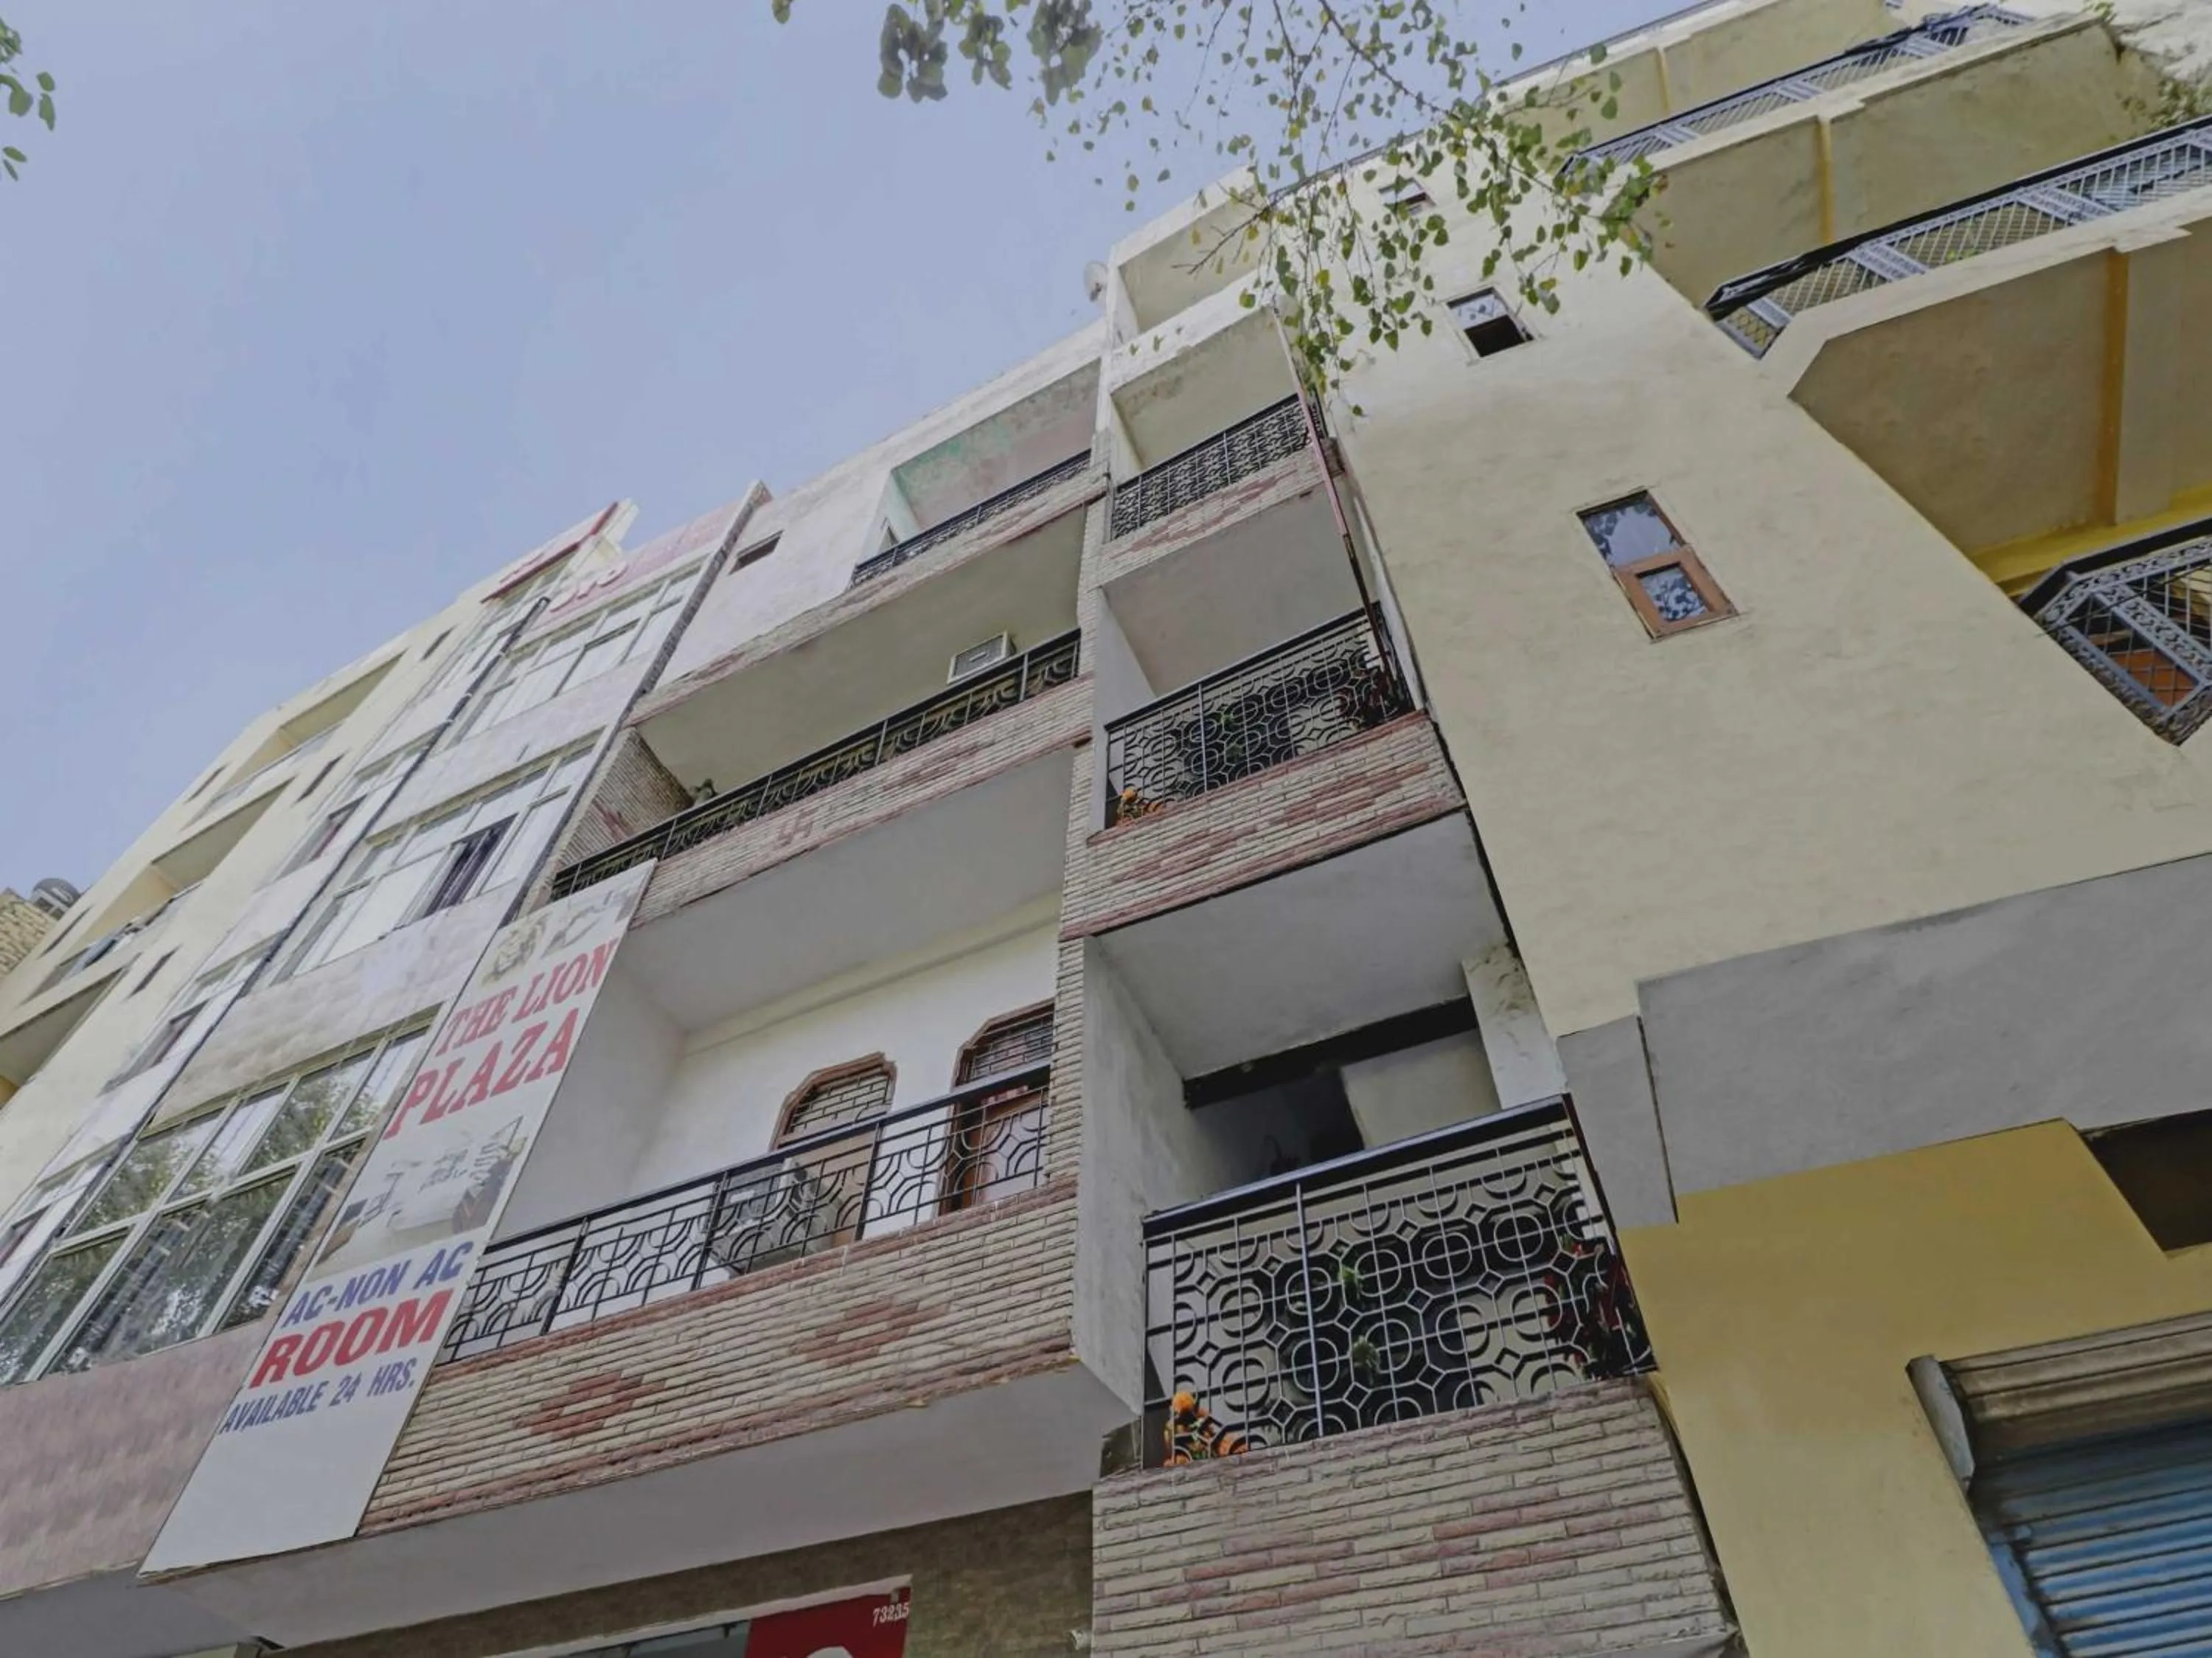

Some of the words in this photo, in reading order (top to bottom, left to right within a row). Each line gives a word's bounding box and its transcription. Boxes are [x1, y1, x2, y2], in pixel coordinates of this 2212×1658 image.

[434, 985, 518, 1057] THE
[512, 937, 619, 1022] LION
[383, 1008, 578, 1140] PLAZA
[281, 1260, 411, 1328] AC-NON
[413, 1241, 474, 1289] AC
[249, 1289, 454, 1390] ROOM
[220, 1381, 329, 1434] AVAILABLE
[330, 1373, 362, 1406] 24
[367, 1359, 417, 1397] HRS.
